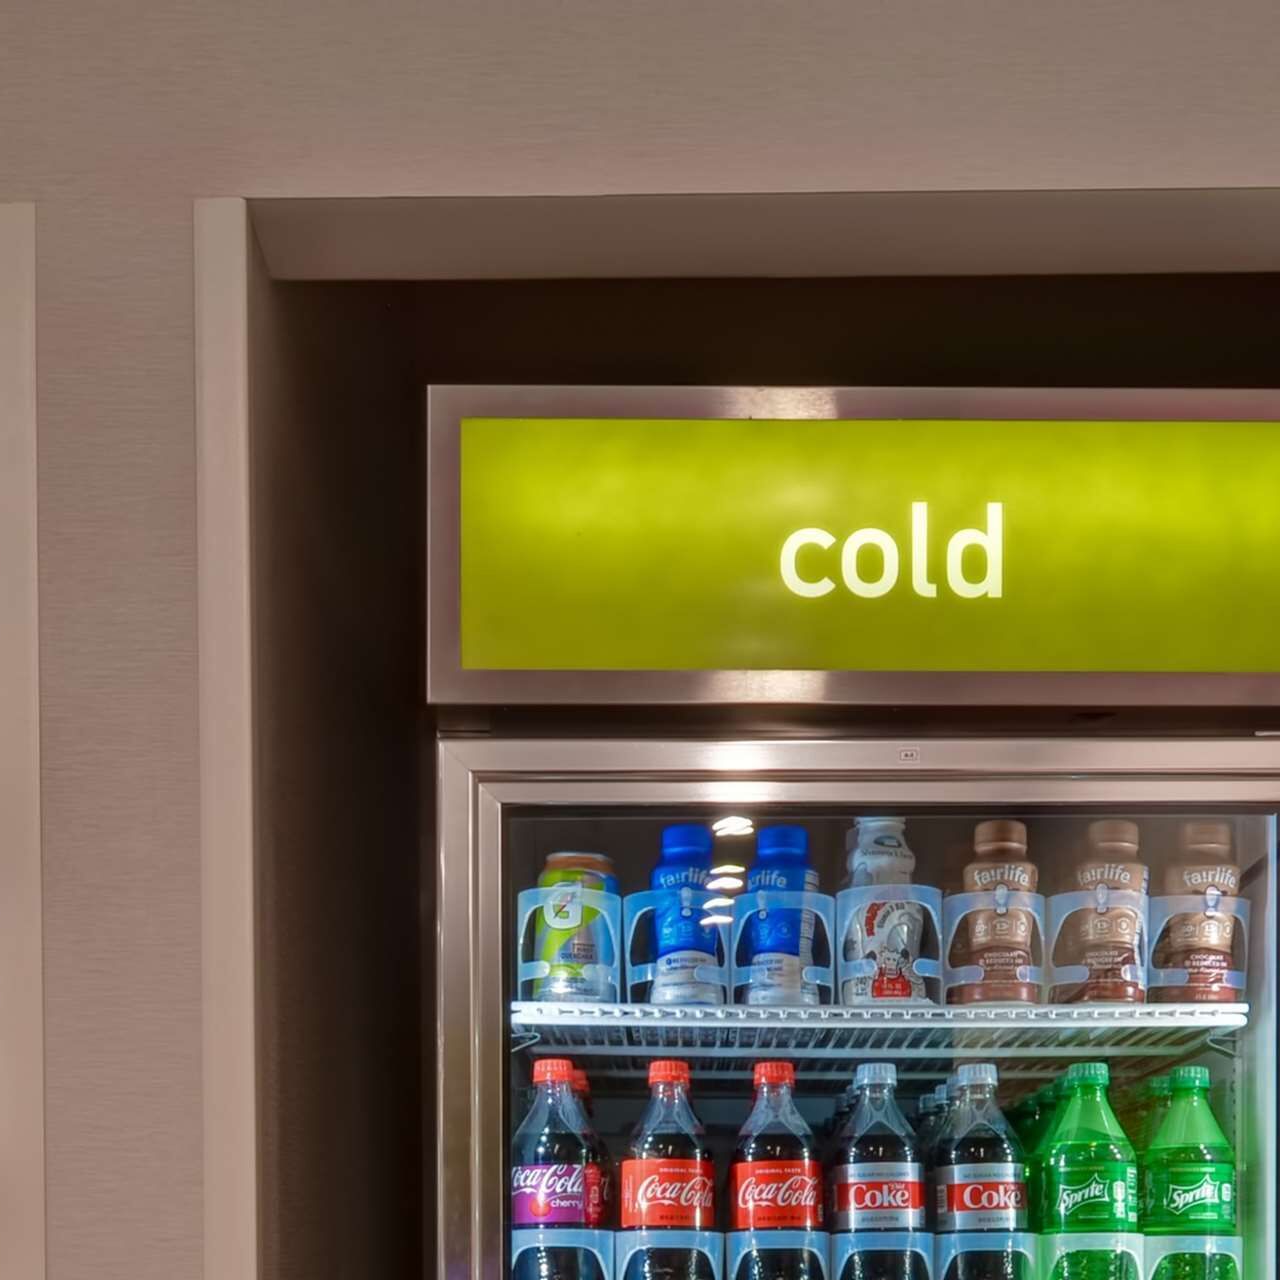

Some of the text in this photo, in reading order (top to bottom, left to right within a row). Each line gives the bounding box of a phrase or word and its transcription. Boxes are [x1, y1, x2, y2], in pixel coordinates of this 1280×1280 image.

[779, 501, 1004, 599] cold
[637, 1174, 714, 1209] Coca-Cola
[738, 1175, 818, 1209] Coca-Cola
[848, 1184, 910, 1209] Coke
[963, 1184, 1021, 1209] Coke
[1061, 1184, 1105, 1206] Sprite
[1171, 1182, 1219, 1206] Sprite
[551, 1199, 584, 1210] cherry
